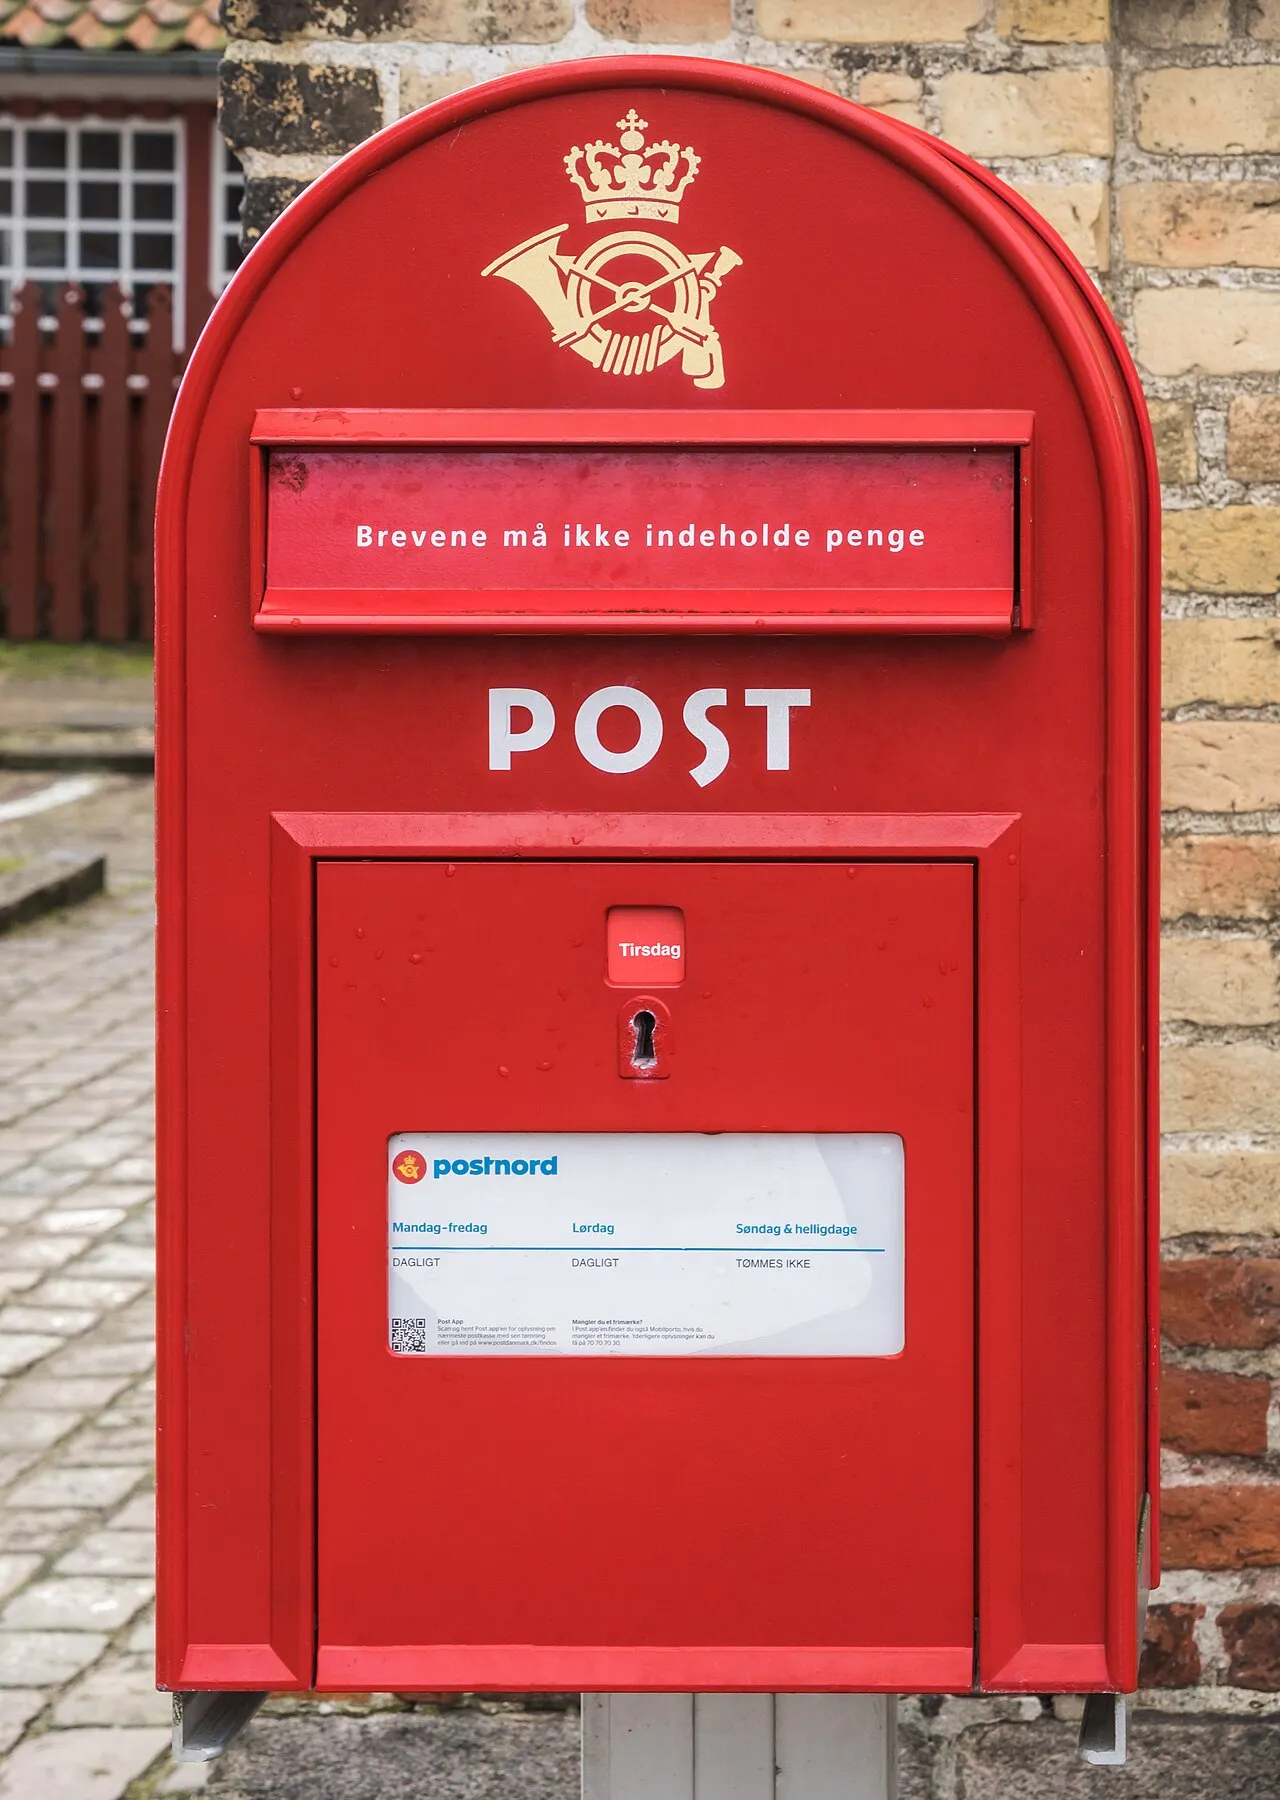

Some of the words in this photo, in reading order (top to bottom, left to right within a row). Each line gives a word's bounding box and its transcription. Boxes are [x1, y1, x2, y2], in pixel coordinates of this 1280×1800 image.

[356, 525, 487, 548] Brevene
[503, 522, 547, 547] må
[564, 523, 630, 547] ikke
[646, 523, 810, 547] indeholde
[826, 529, 925, 553] penge
[488, 685, 811, 788] POST
[618, 942, 681, 960] Tirsdag
[433, 1155, 558, 1179] postnord
[392, 1221, 488, 1236] Mandag-fredag
[572, 1222, 615, 1236] Lørdag
[736, 1223, 781, 1237] Søndag
[783, 1224, 793, 1235] &
[795, 1224, 858, 1237] helligdage
[392, 1257, 441, 1268] DAGLIGT
[571, 1257, 620, 1268] DAGLIGT
[735, 1259, 784, 1269] TØMMES
[786, 1259, 811, 1269] IKKE
